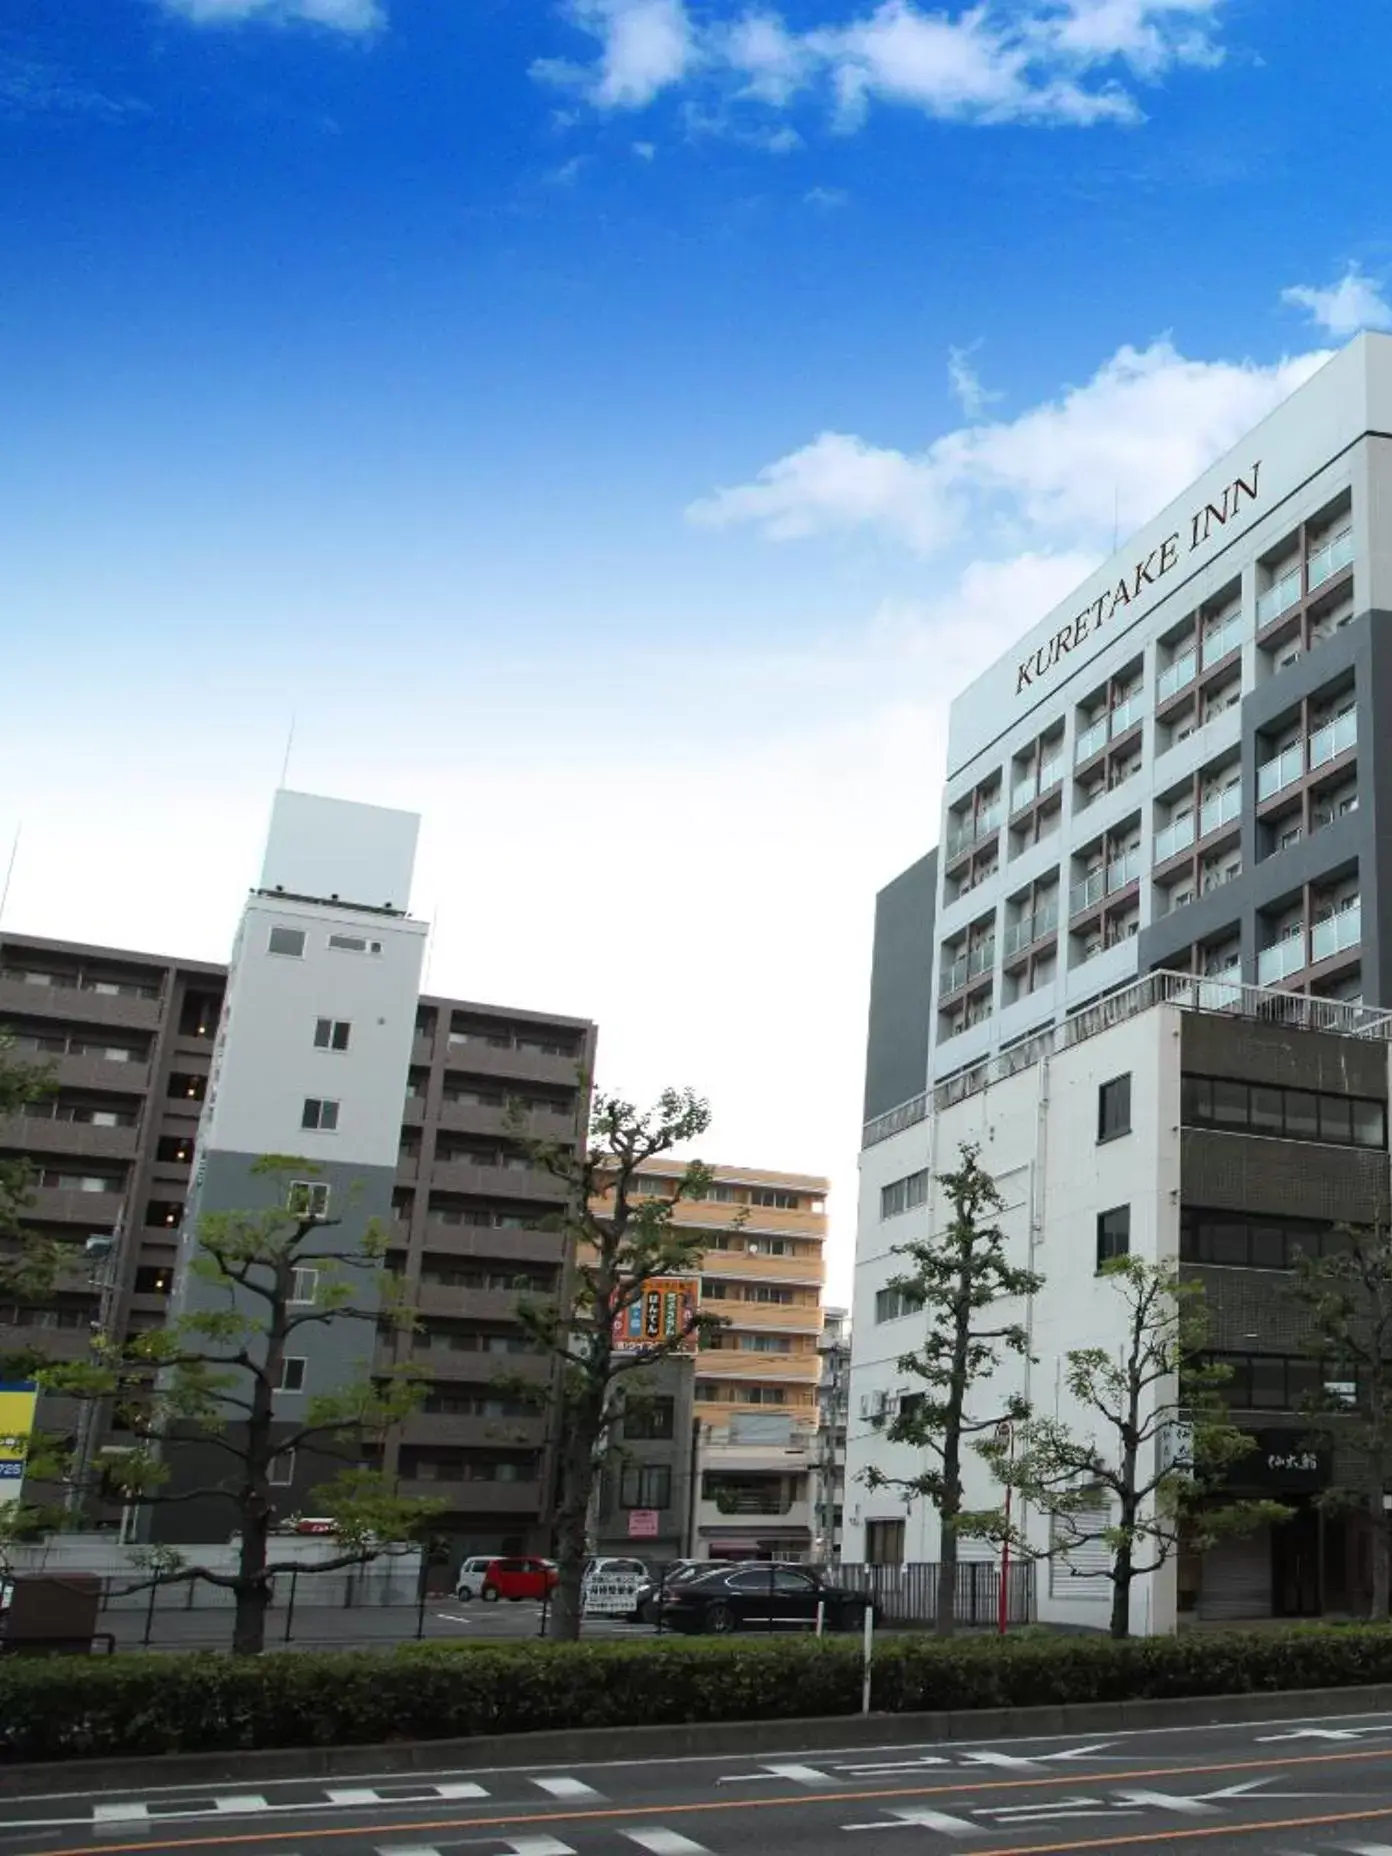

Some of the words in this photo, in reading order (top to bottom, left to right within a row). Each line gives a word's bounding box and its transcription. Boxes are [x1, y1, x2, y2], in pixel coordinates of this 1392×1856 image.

[1015, 531, 1180, 696] KURETAKE
[1189, 459, 1262, 552] INN
[648, 1294, 660, 1334] はんてん
